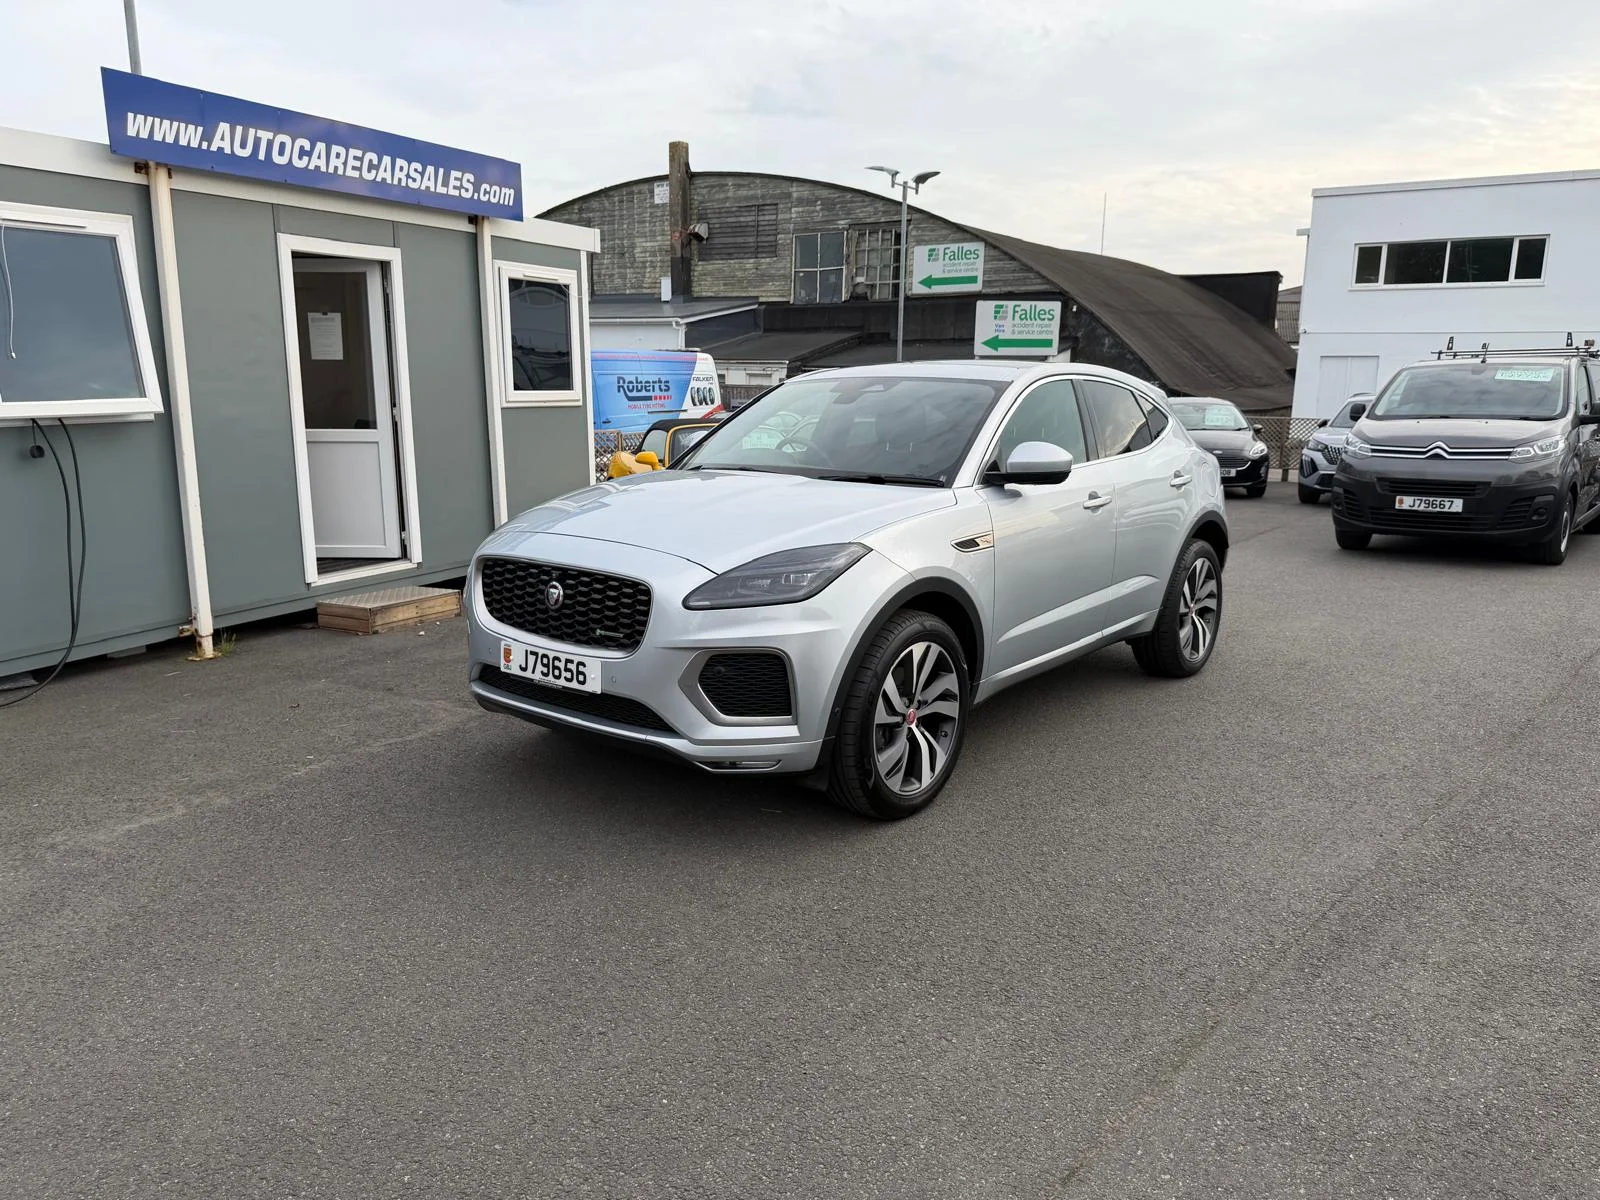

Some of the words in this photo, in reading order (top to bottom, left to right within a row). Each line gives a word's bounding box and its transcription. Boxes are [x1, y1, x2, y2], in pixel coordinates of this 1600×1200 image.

[942, 246, 979, 261] Falles
[1012, 304, 1055, 321] Falles
[1035, 322, 1053, 330] repair
[617, 376, 670, 394] Roberts
[1409, 498, 1454, 510] J79667
[519, 649, 587, 686] J79656
